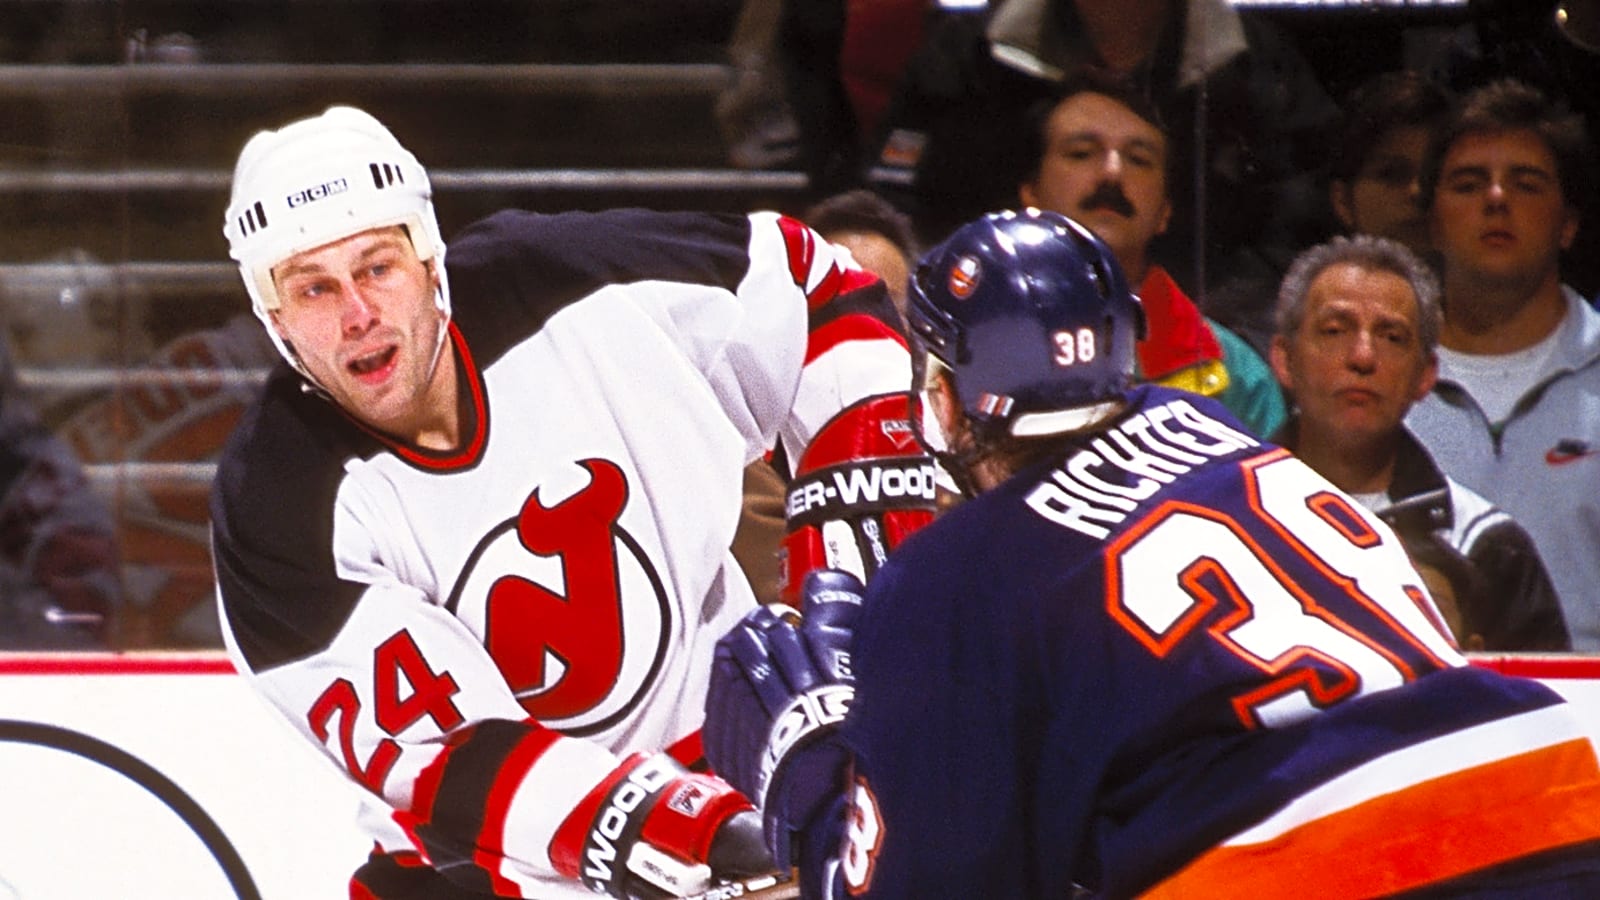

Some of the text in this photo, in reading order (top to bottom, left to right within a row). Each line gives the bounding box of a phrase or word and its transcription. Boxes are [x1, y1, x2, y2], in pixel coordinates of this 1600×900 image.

[1053, 328, 1096, 366] 38
[1024, 400, 1260, 540] RICHTER
[1105, 447, 1470, 730] 38
[306, 628, 467, 798] 24
